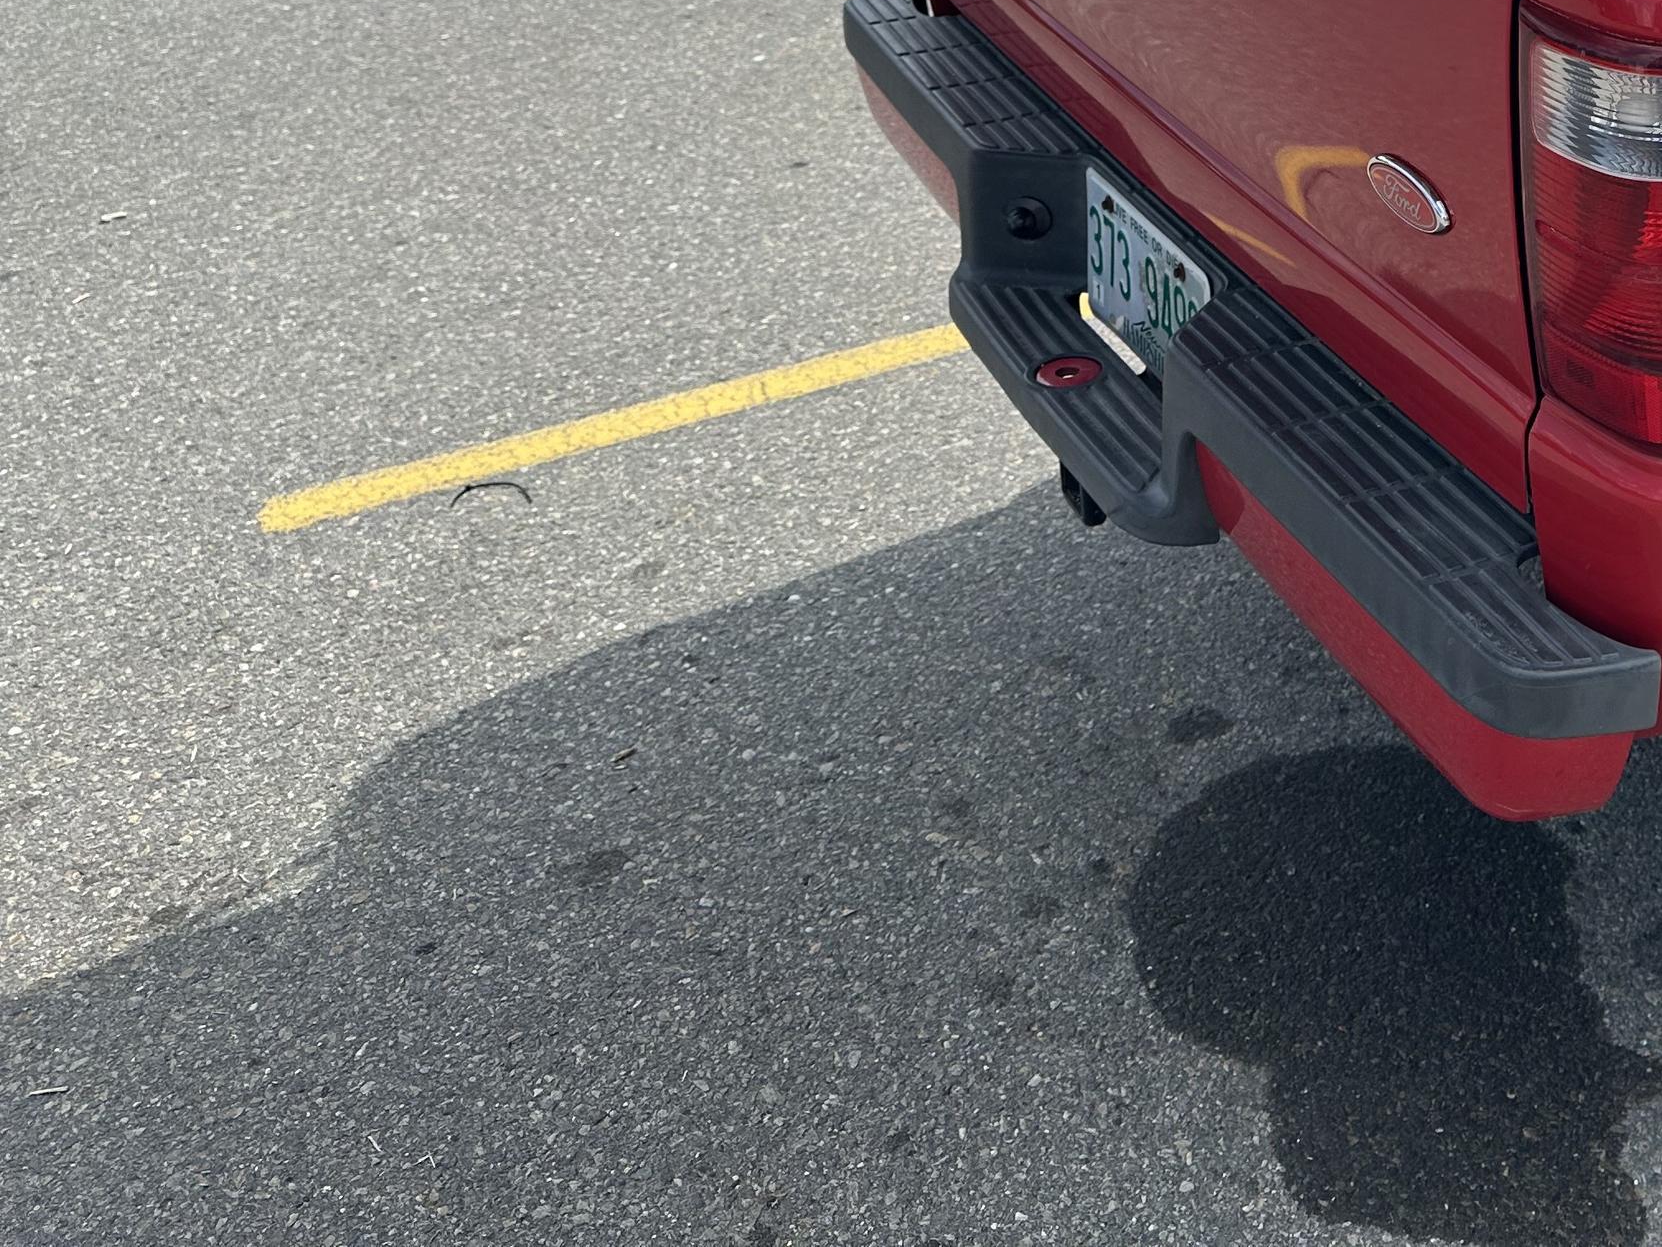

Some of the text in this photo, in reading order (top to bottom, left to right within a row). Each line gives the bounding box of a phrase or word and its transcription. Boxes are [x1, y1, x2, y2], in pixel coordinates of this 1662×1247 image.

[1383, 174, 1421, 220] Ford
[1090, 205, 1132, 302] 373
[1130, 216, 1149, 245] FREE
[1151, 237, 1163, 258] OR
